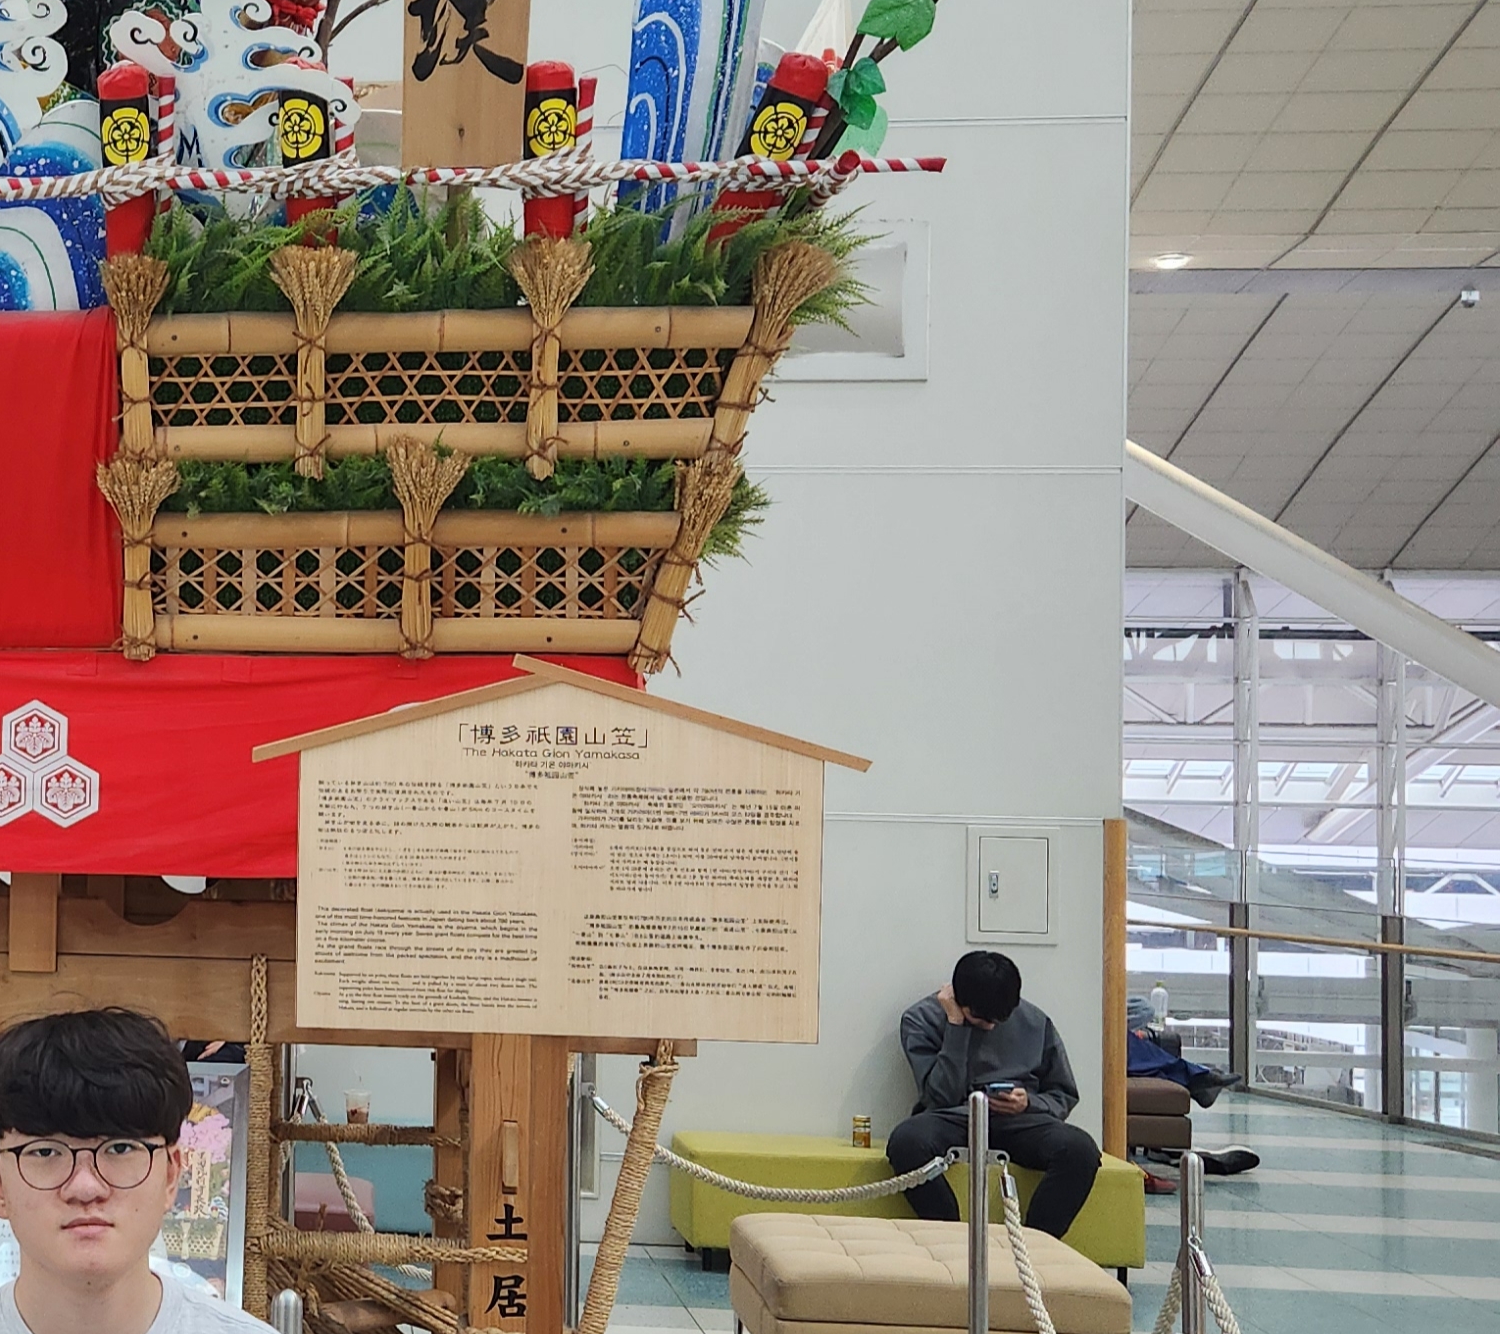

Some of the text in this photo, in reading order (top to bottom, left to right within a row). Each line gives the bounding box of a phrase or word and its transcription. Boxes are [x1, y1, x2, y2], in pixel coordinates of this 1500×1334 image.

[462, 747, 640, 760] The Hakata Gion Yamakasa
